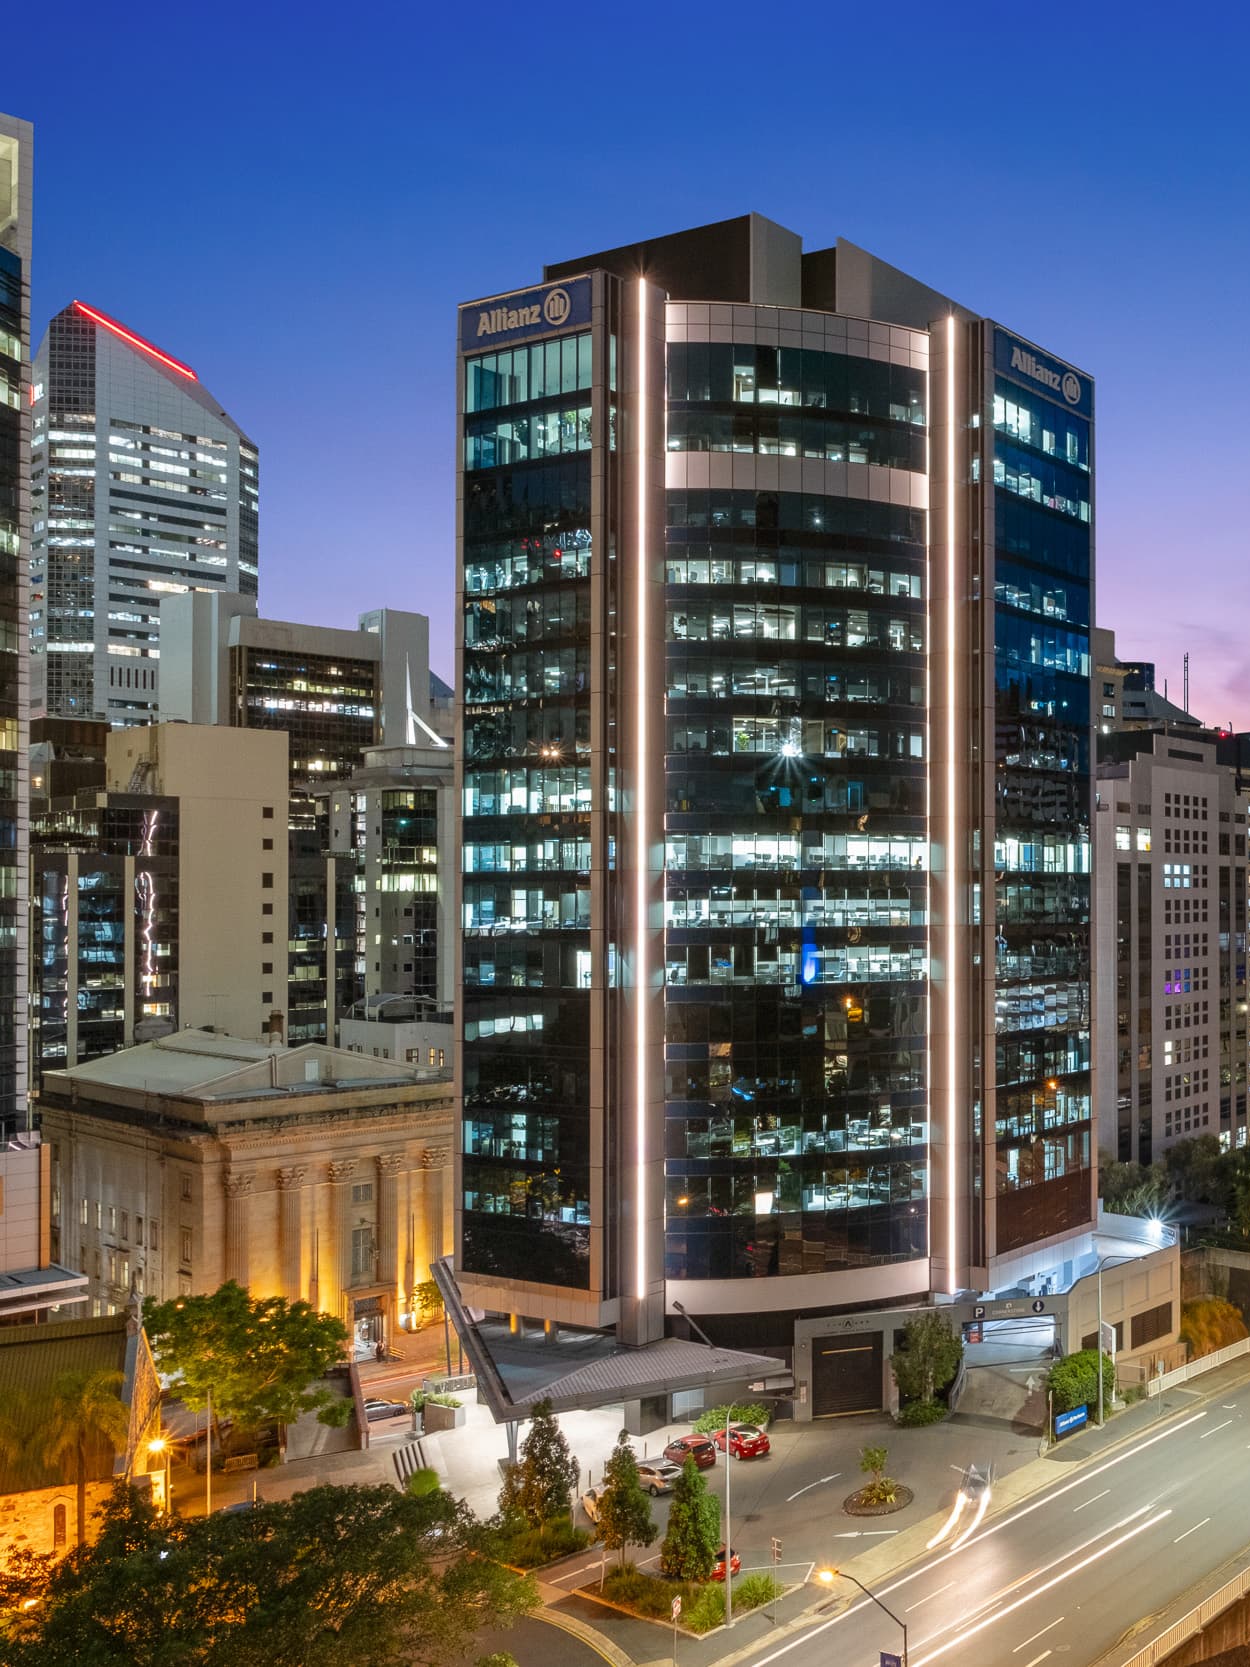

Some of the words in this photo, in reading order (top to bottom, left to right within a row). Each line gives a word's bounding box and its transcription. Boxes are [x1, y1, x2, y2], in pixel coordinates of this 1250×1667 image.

[477, 304, 541, 336] Allianz
[1011, 346, 1061, 391] Allianz
[975, 1307, 984, 1318] P
